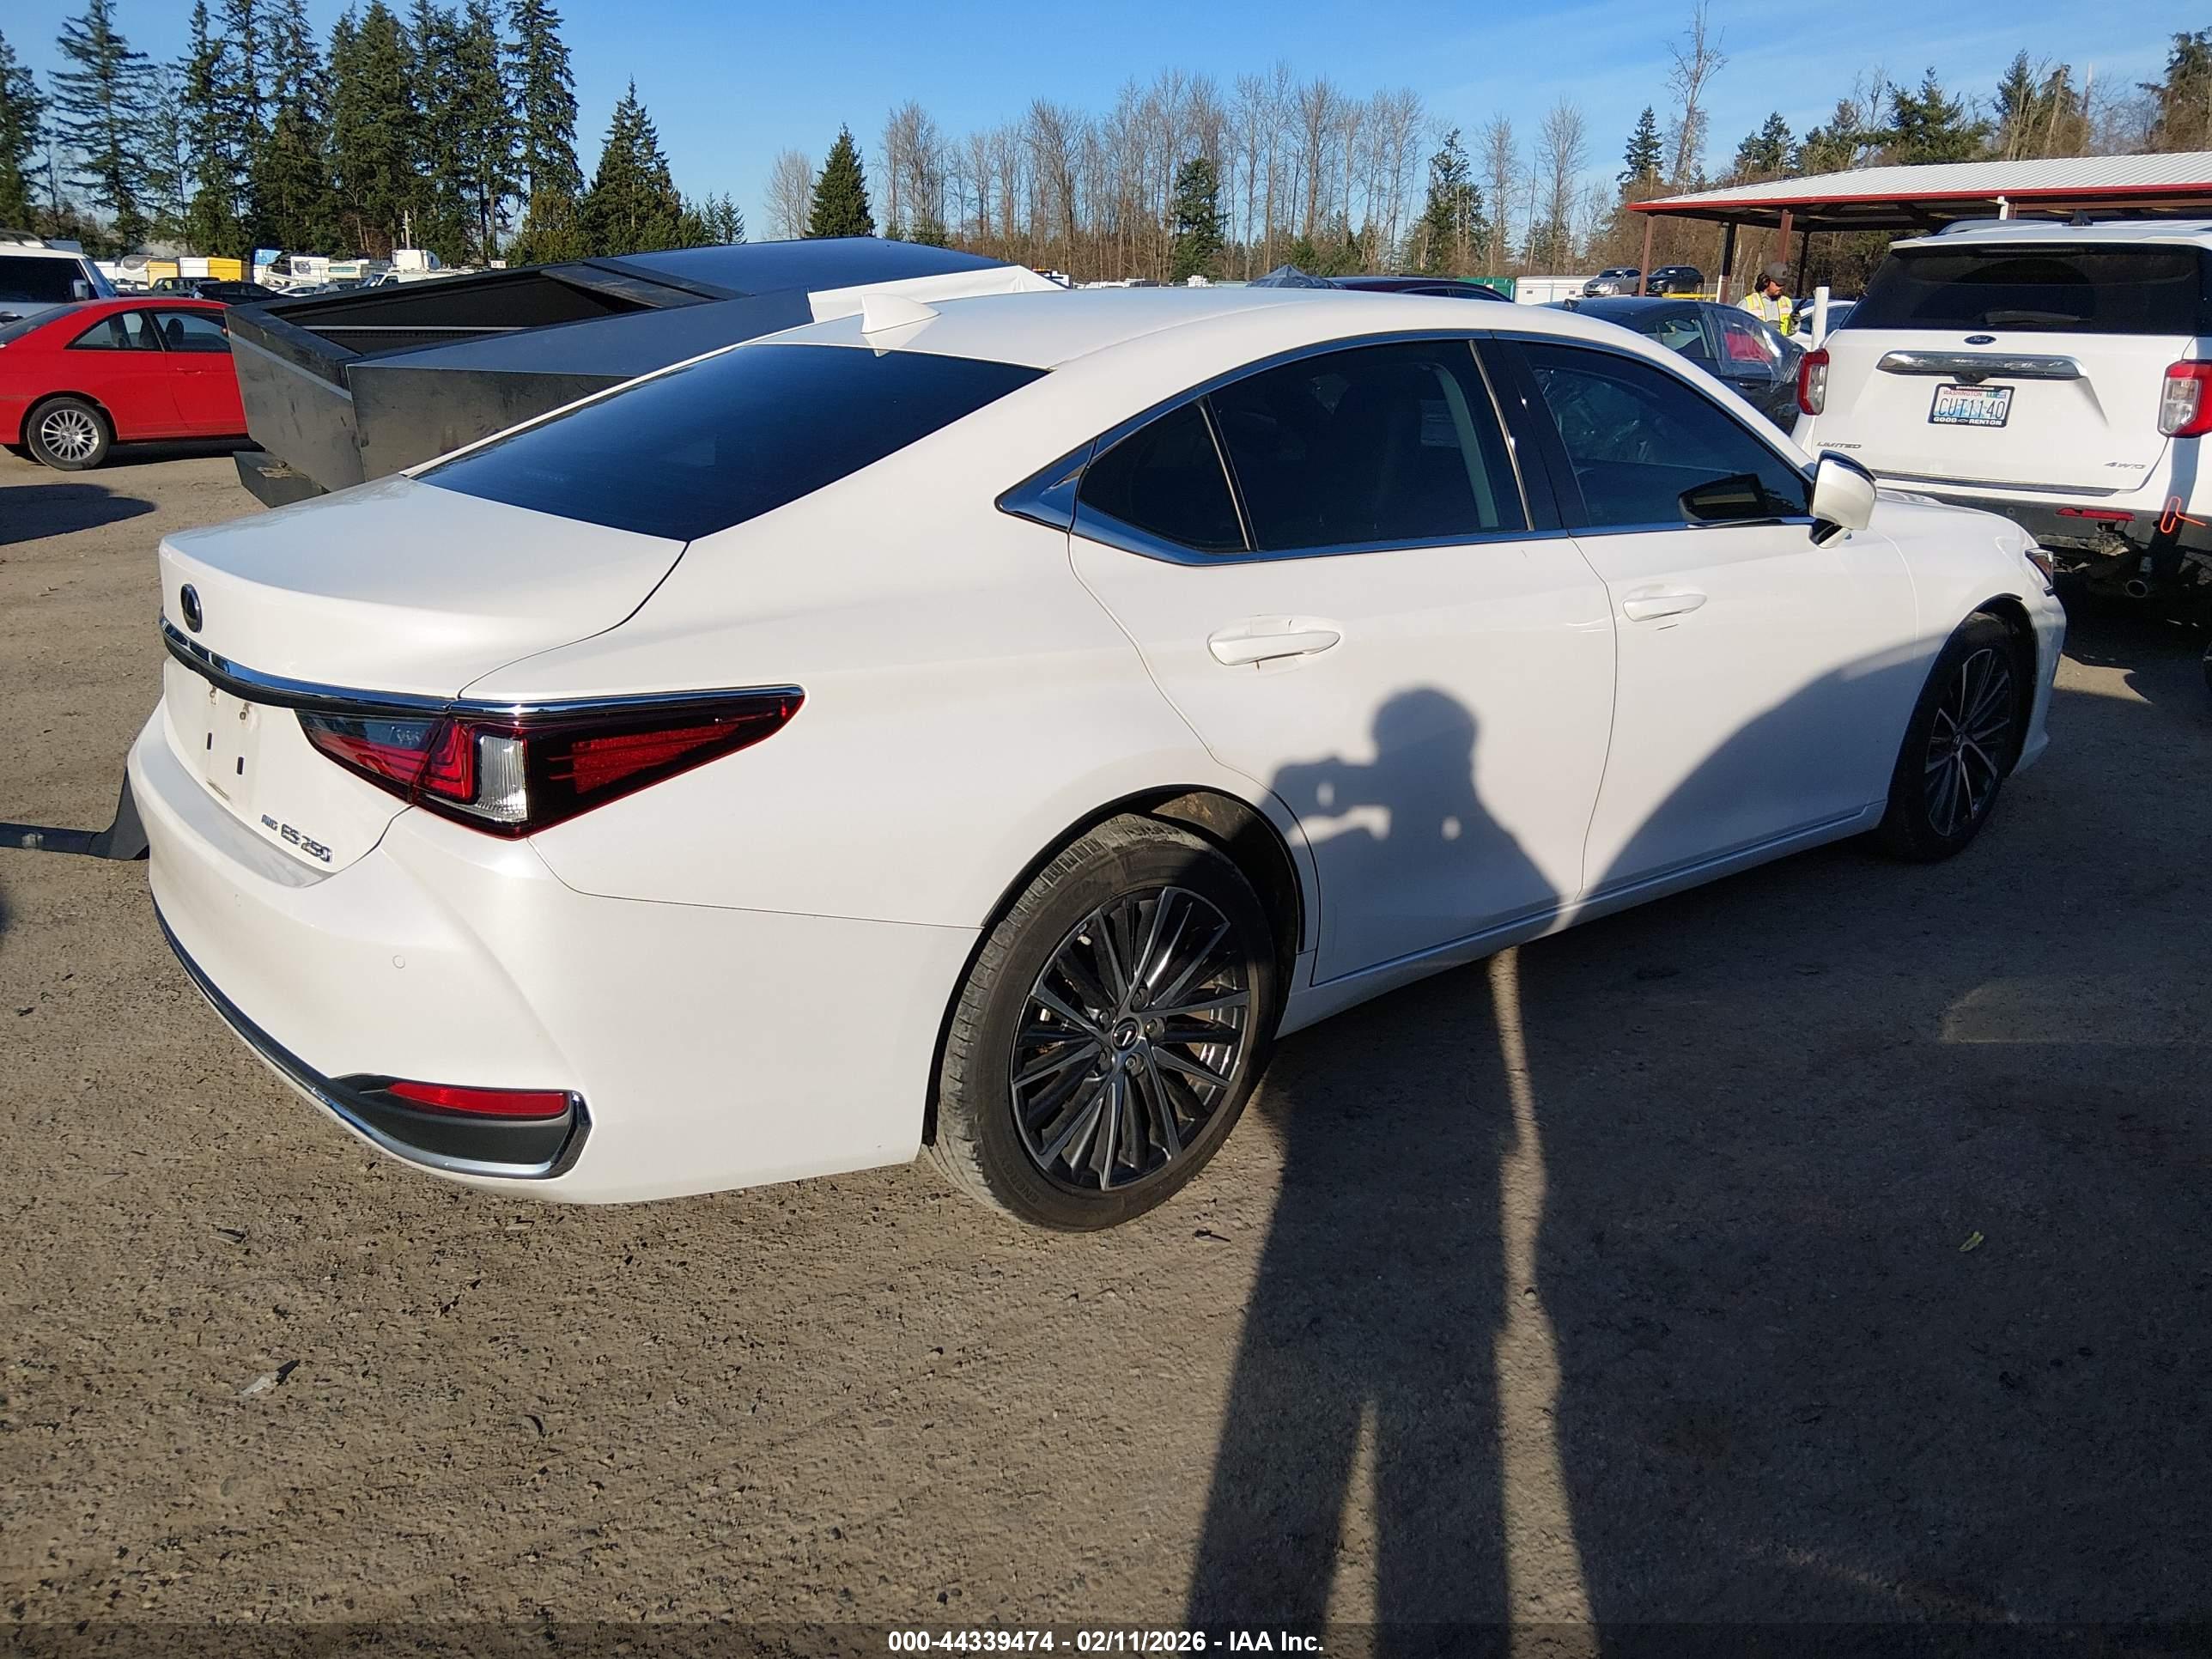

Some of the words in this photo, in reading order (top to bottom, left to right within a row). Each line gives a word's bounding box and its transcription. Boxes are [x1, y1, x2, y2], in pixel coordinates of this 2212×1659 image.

[1938, 398, 2006, 419] CUT1140
[281, 823, 301, 845] ES
[301, 835, 331, 863] 250
